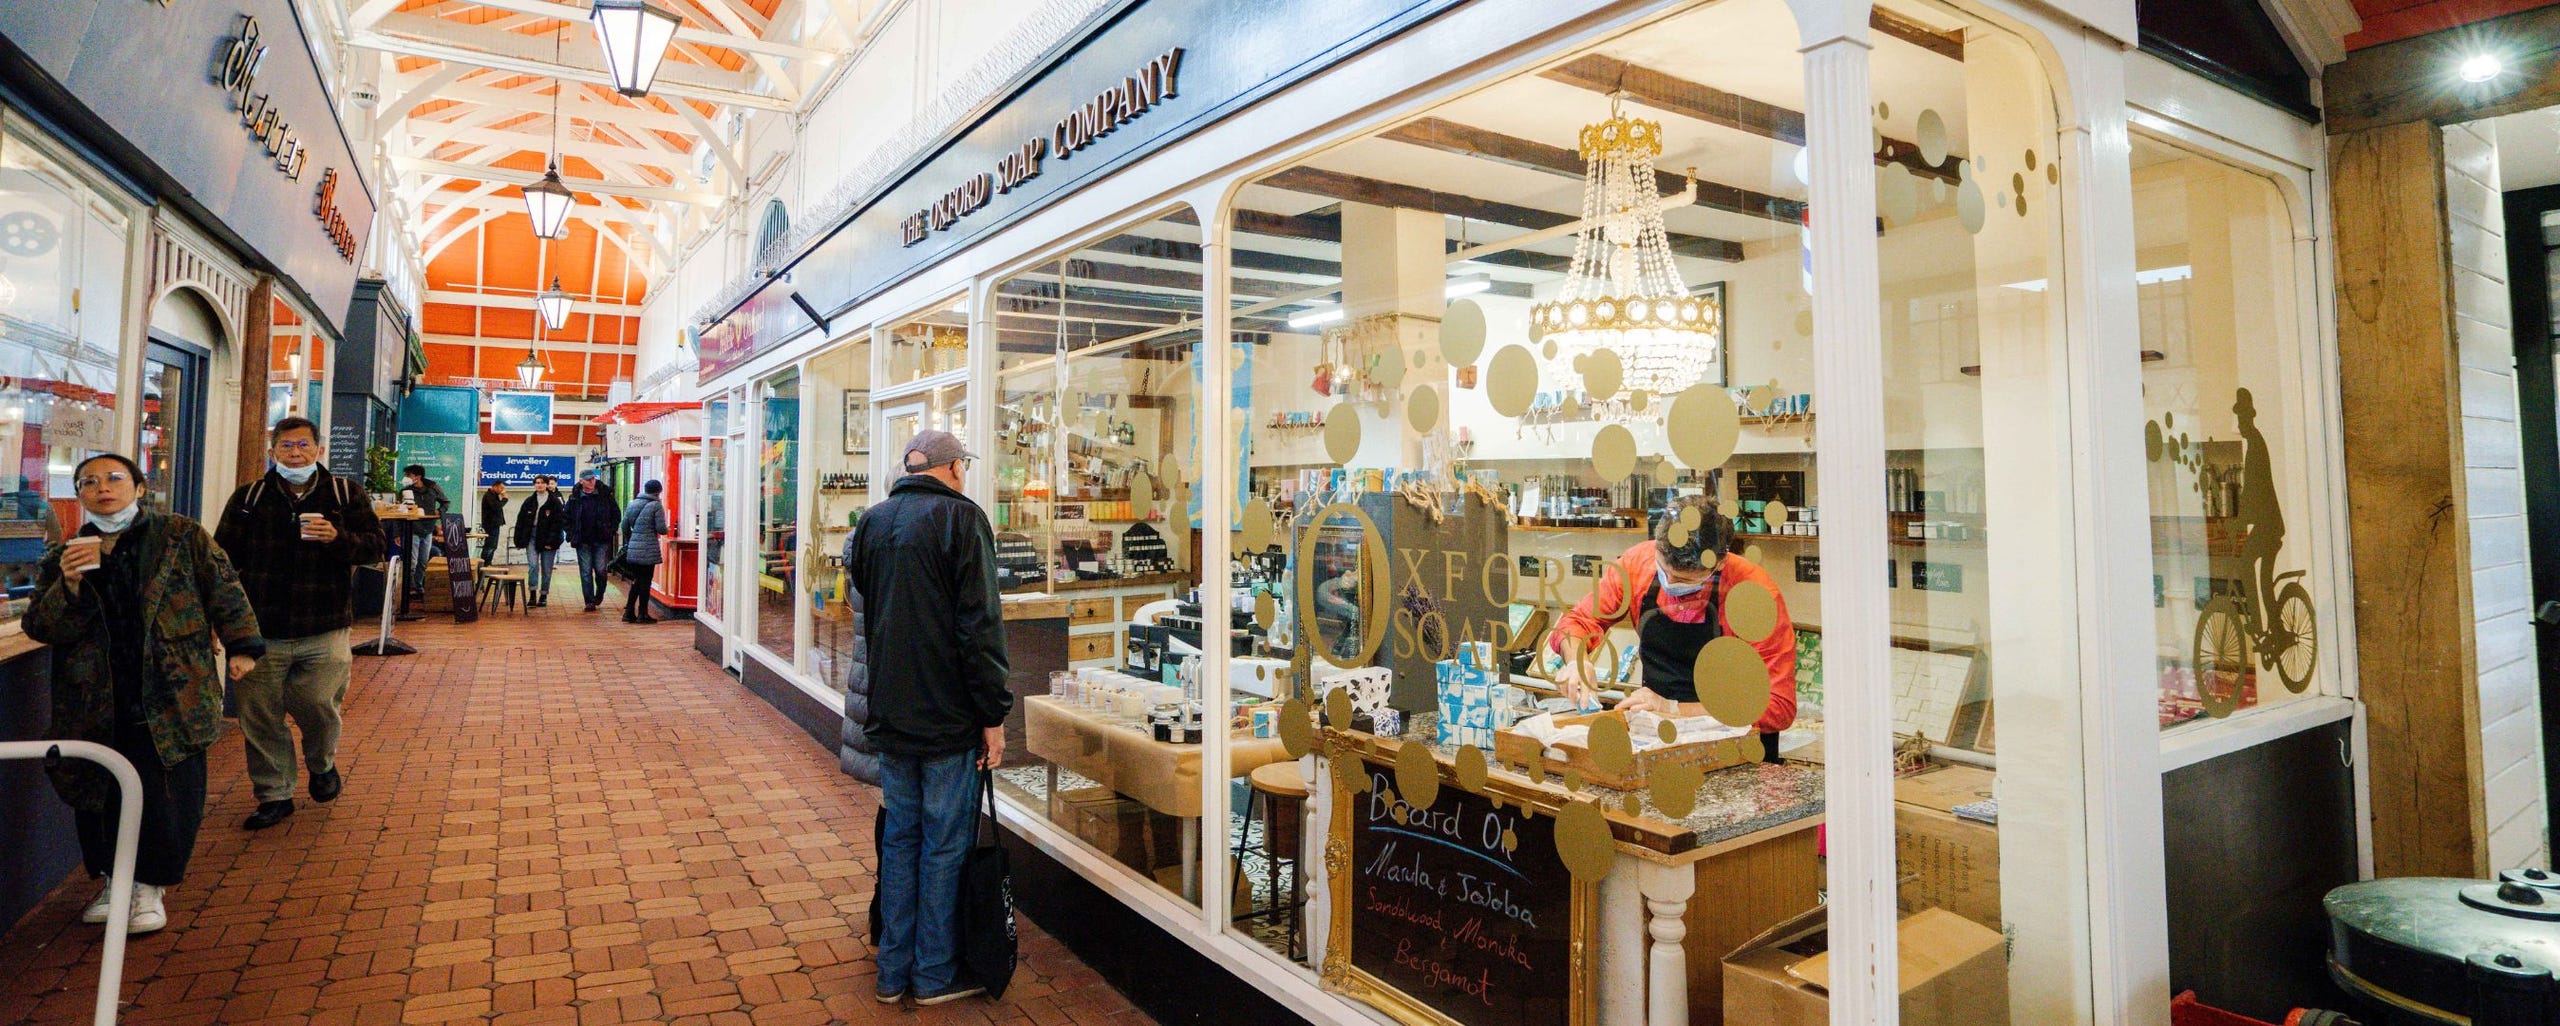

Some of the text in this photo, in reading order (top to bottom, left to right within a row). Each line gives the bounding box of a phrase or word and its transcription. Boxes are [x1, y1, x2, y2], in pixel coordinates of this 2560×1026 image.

[900, 47, 1186, 247] THE OXFORD SOAP COMPANY
[481, 471, 571, 480] Fashion Accories
[505, 457, 549, 466] Jewellery
[1299, 502, 1632, 669] OXFORD
[1394, 608, 1513, 673] SOAP
[1365, 841, 1434, 890] Marula
[1394, 938, 1497, 1006] Bergamot
